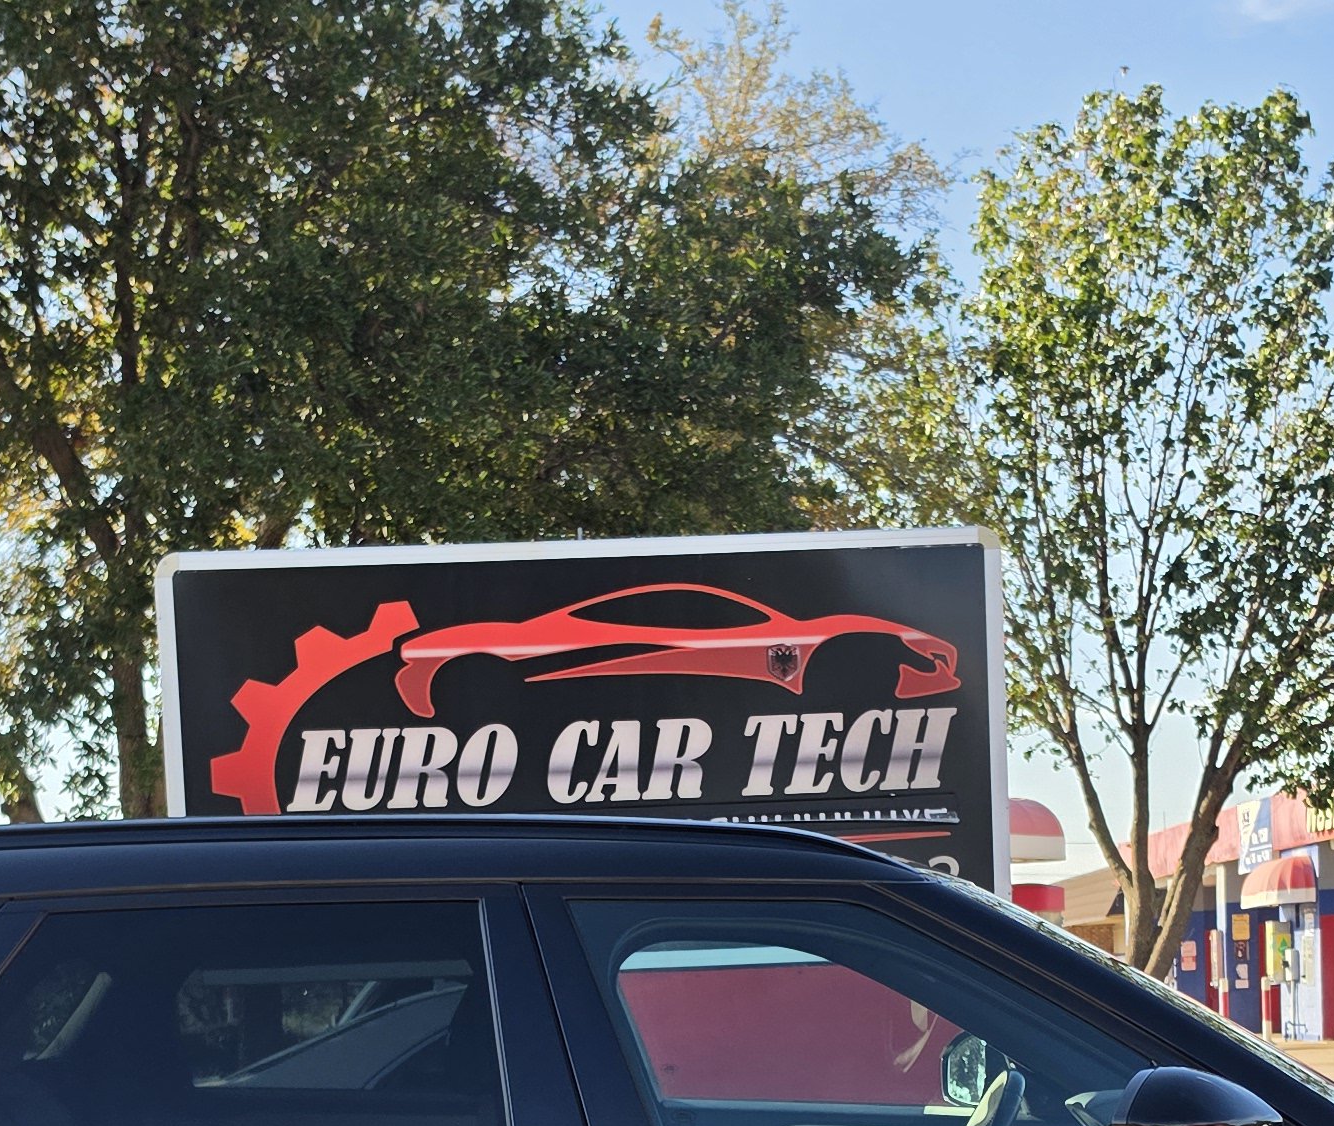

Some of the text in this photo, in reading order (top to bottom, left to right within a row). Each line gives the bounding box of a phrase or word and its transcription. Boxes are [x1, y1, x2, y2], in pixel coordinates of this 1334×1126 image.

[287, 707, 958, 811] EURO CAR TECH
